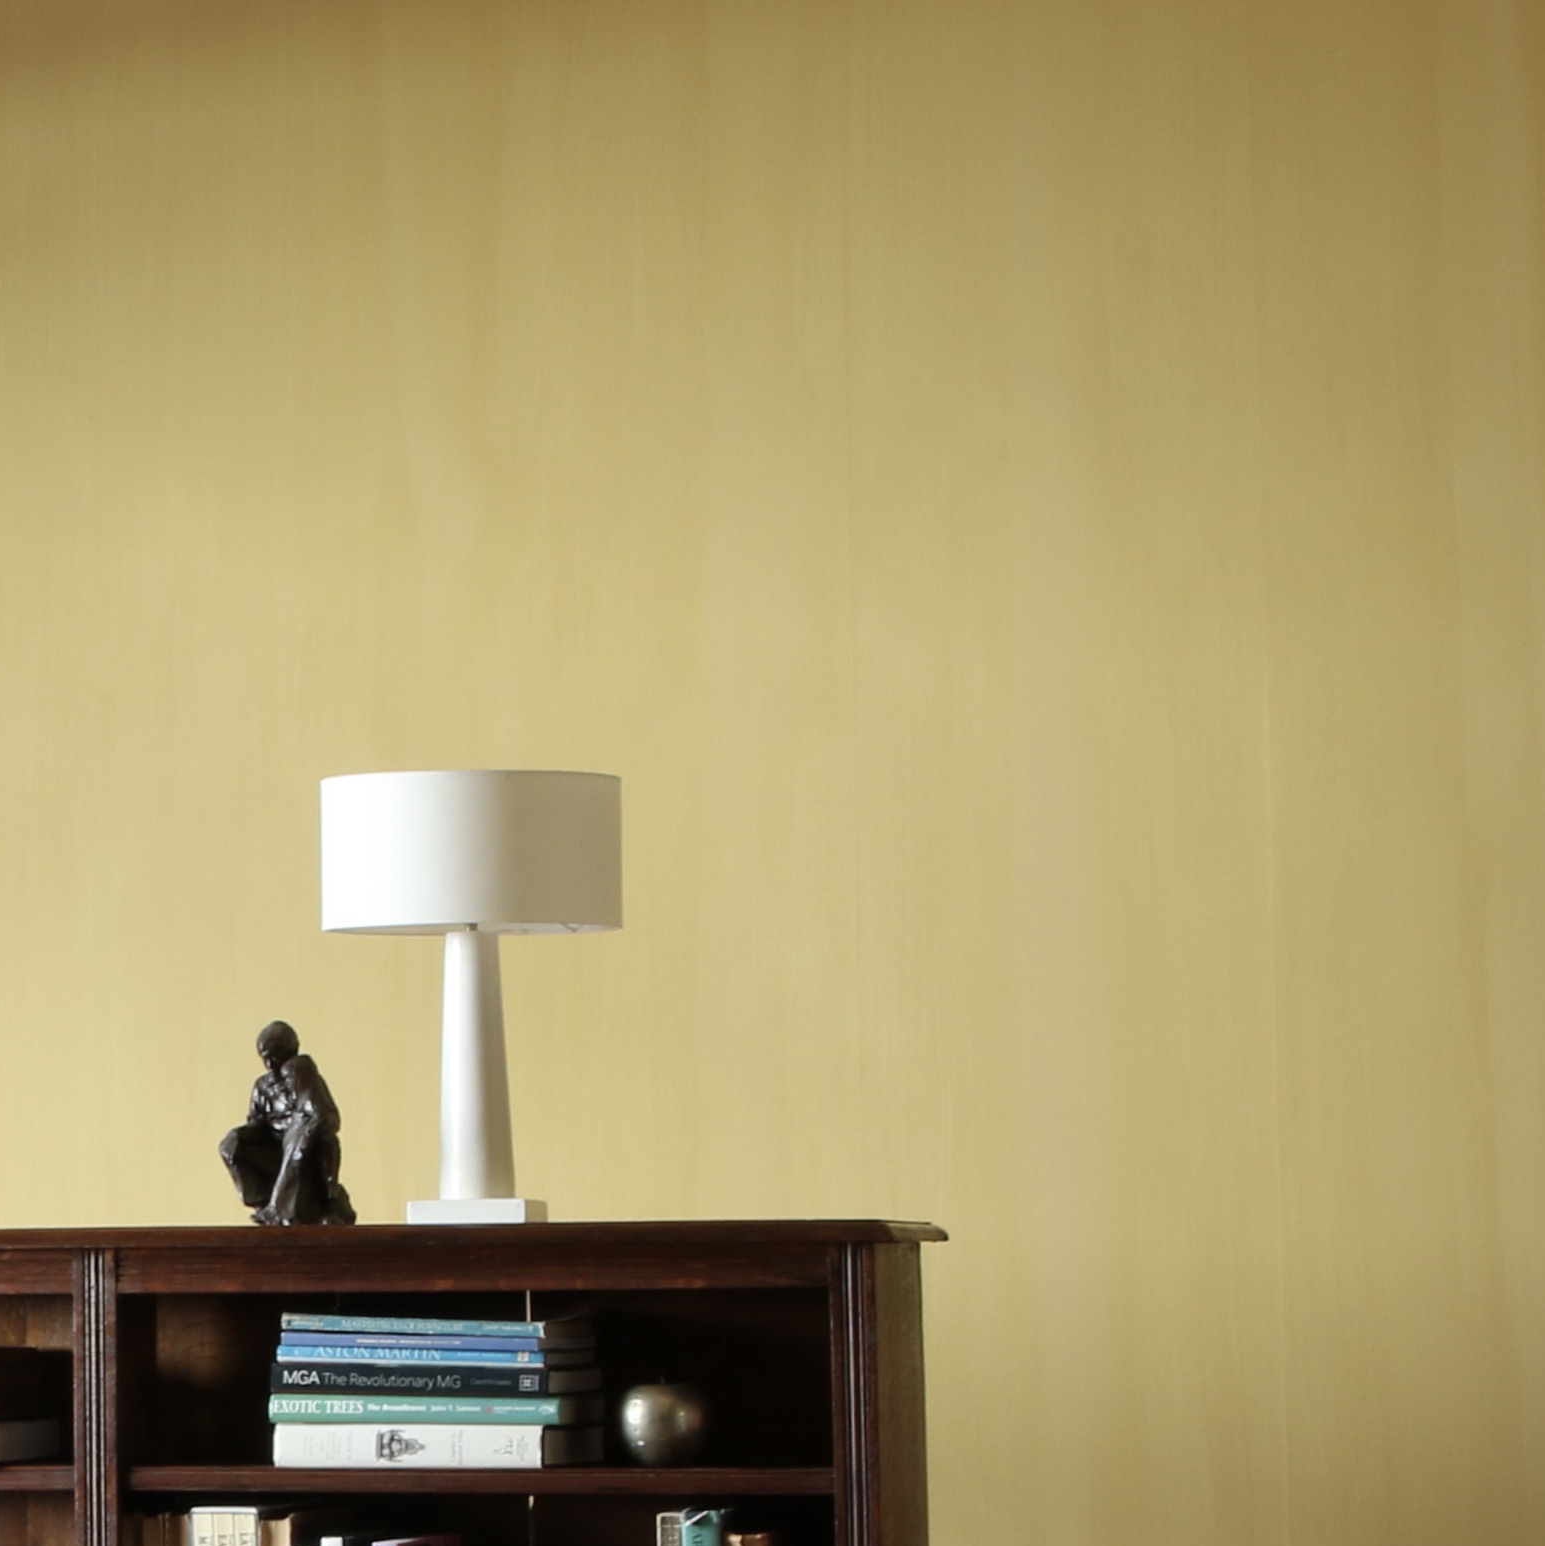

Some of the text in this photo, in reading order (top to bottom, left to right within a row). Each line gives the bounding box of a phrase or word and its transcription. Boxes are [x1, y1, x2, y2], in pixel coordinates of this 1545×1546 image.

[314, 1346, 441, 1360] ASTON MARTIN
[282, 1370, 320, 1385] MGA
[322, 1372, 346, 1386] The
[349, 1373, 435, 1391] Revolutionary
[437, 1375, 461, 1389] MG
[273, 1399, 321, 1414] EXOTIC
[324, 1400, 364, 1414] TREES
